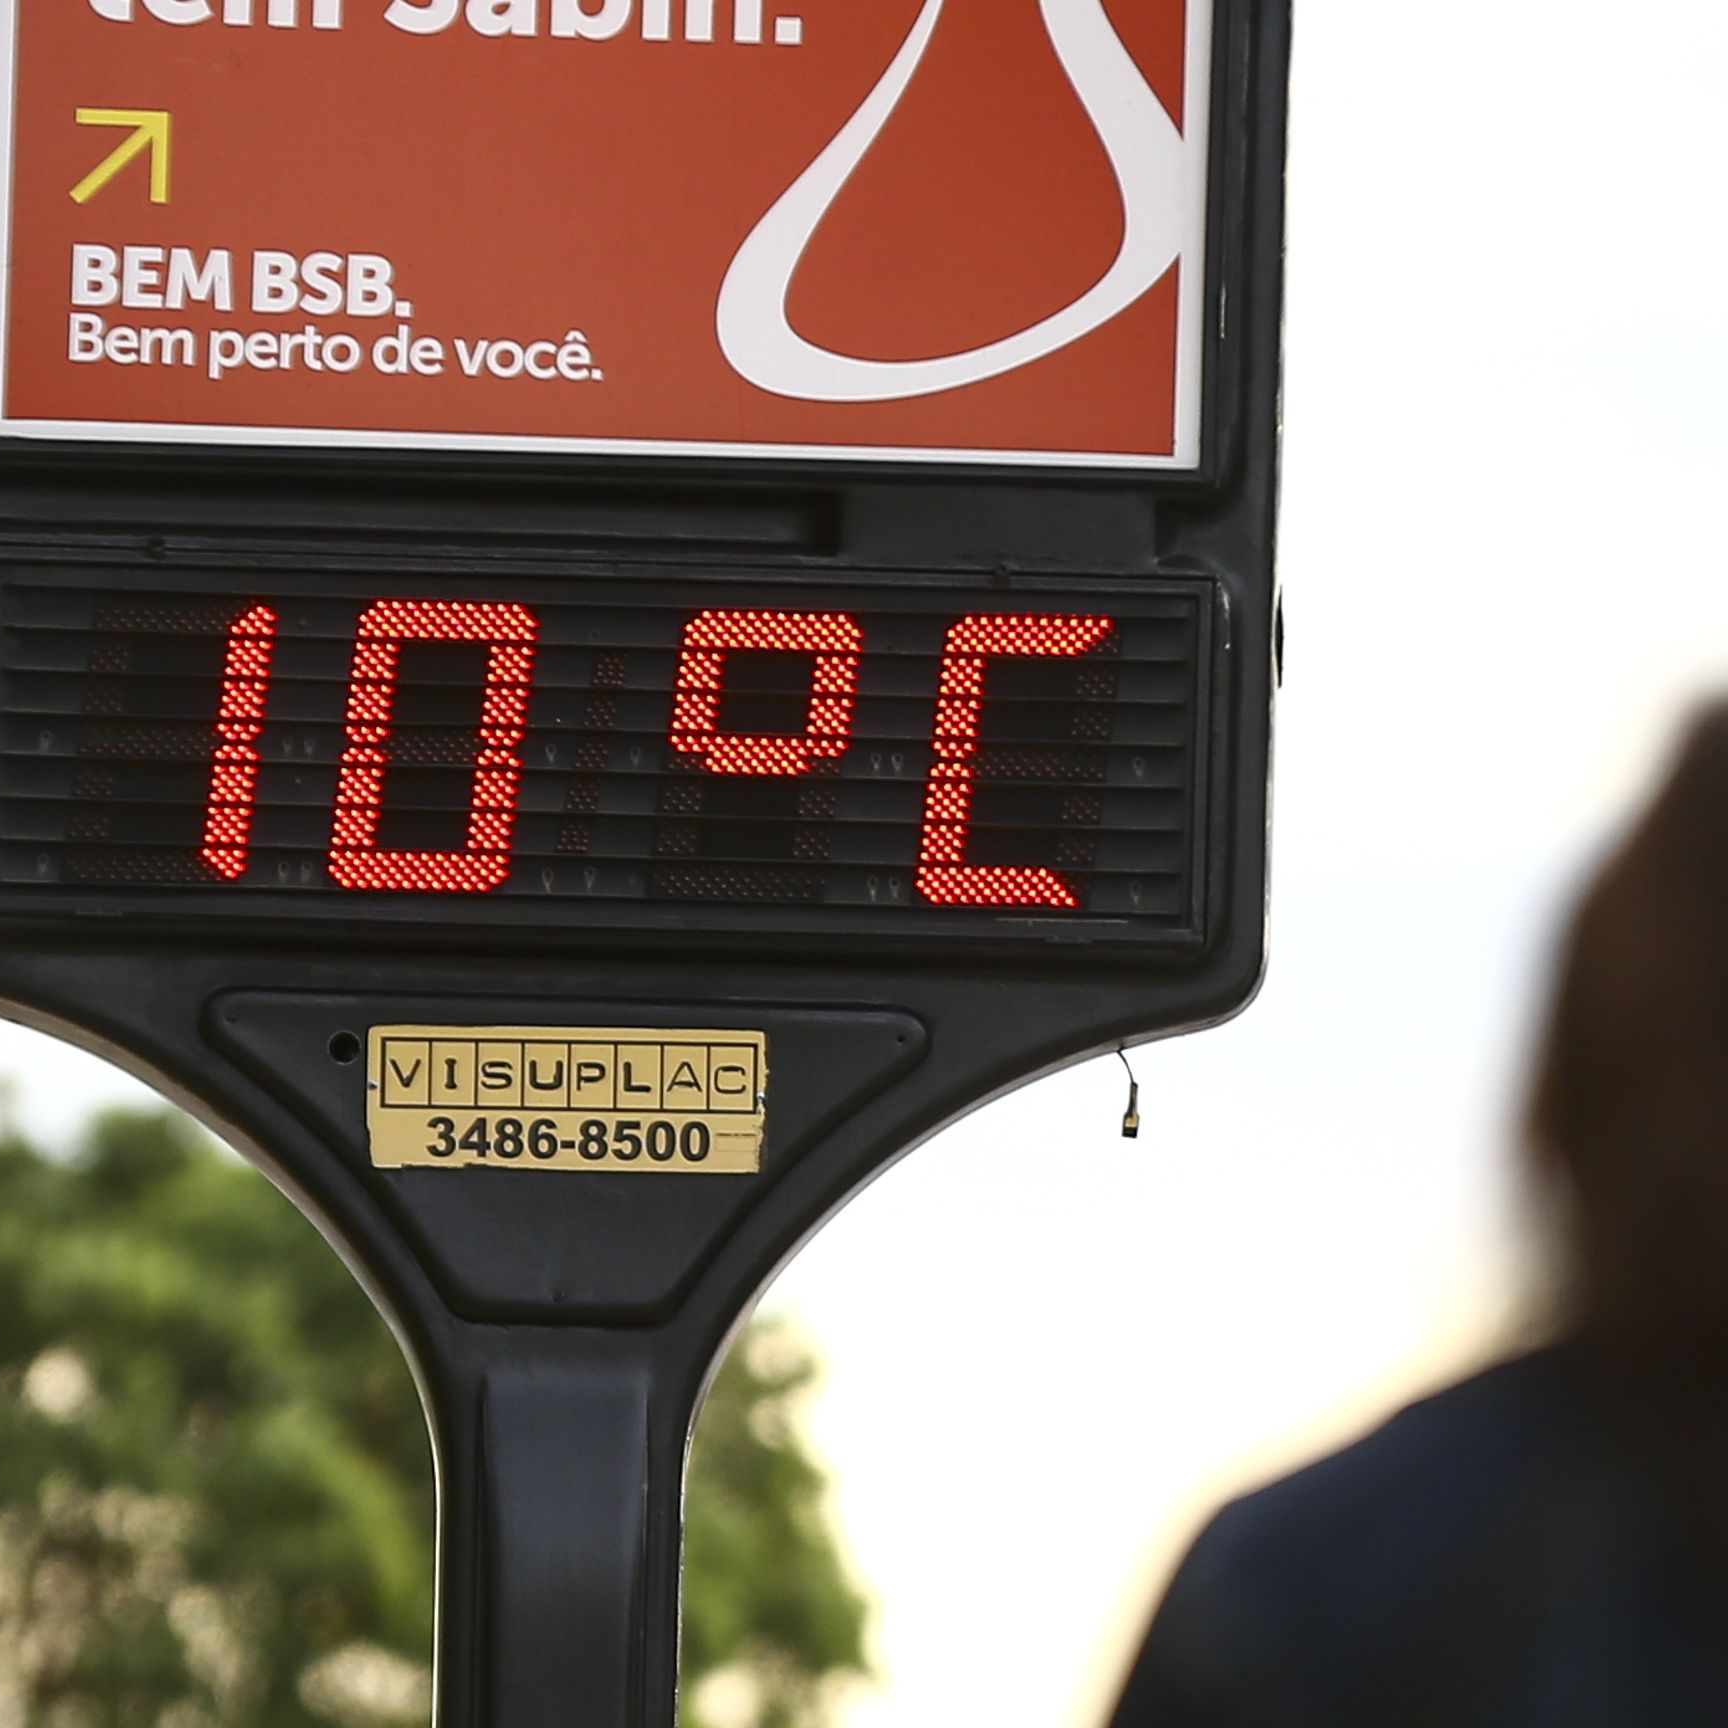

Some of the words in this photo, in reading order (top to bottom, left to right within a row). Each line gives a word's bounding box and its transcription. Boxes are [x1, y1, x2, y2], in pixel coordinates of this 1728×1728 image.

[71, 243, 234, 312] BEM
[252, 251, 414, 317] BSB.
[68, 313, 198, 367] Bem
[208, 324, 361, 380] perto
[372, 325, 445, 376] de
[454, 330, 604, 381] você.
[202, 598, 539, 891] 10
[389, 1057, 747, 1095] VISUPLAC
[426, 1116, 711, 1162] 3486-8500
